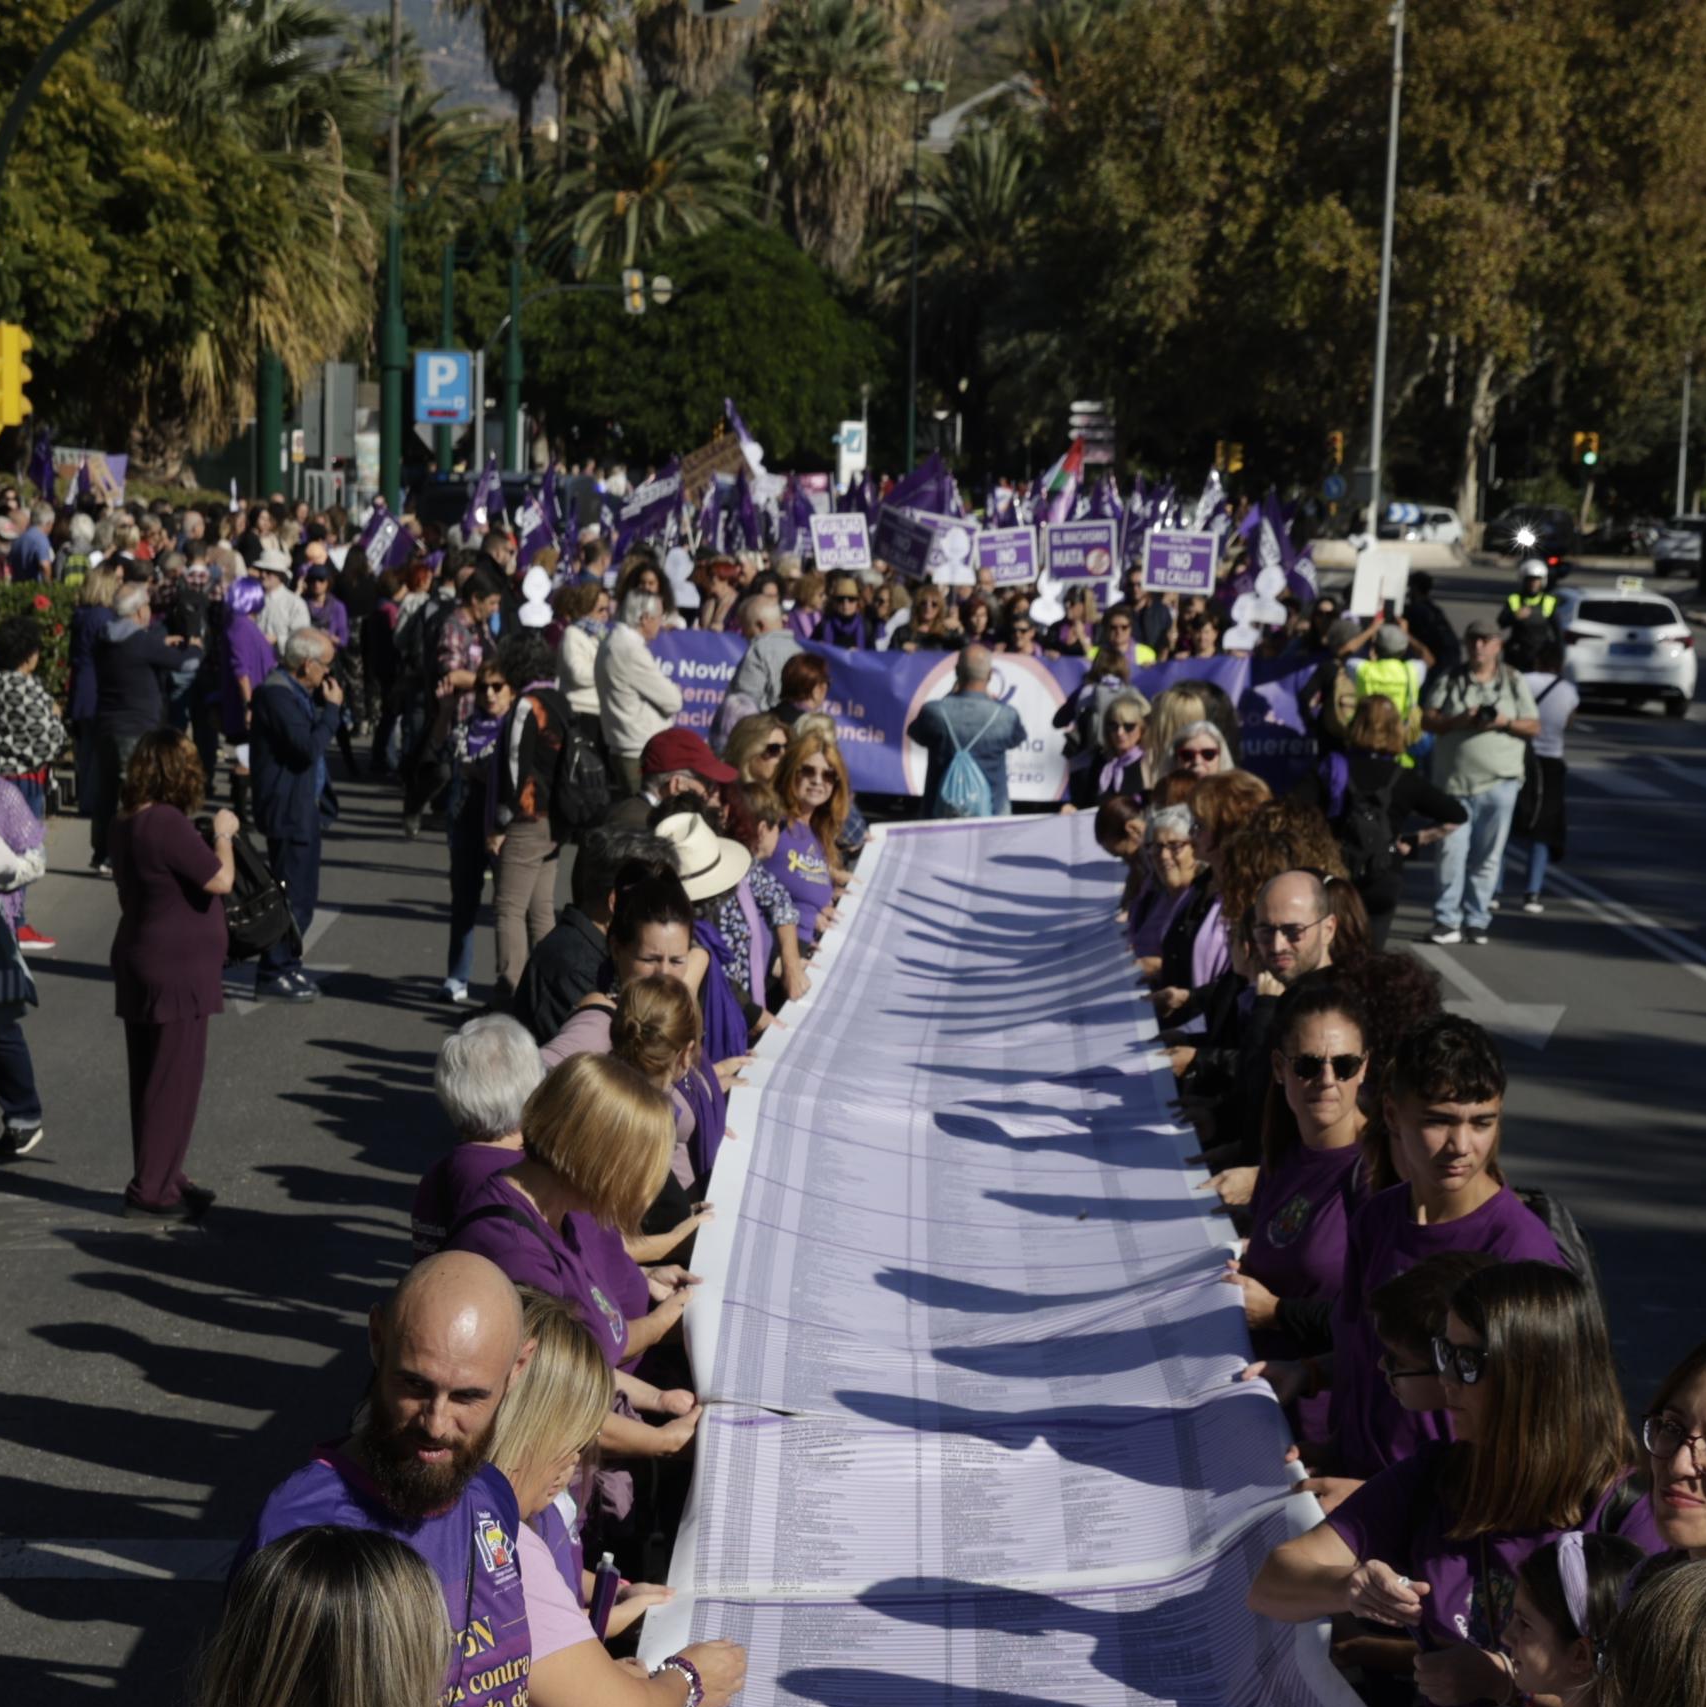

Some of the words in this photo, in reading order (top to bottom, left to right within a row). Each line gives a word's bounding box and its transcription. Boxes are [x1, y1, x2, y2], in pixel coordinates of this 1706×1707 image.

[427, 355, 459, 397] P
[679, 659, 736, 680] Novie
[468, 1655, 529, 1694] contra
